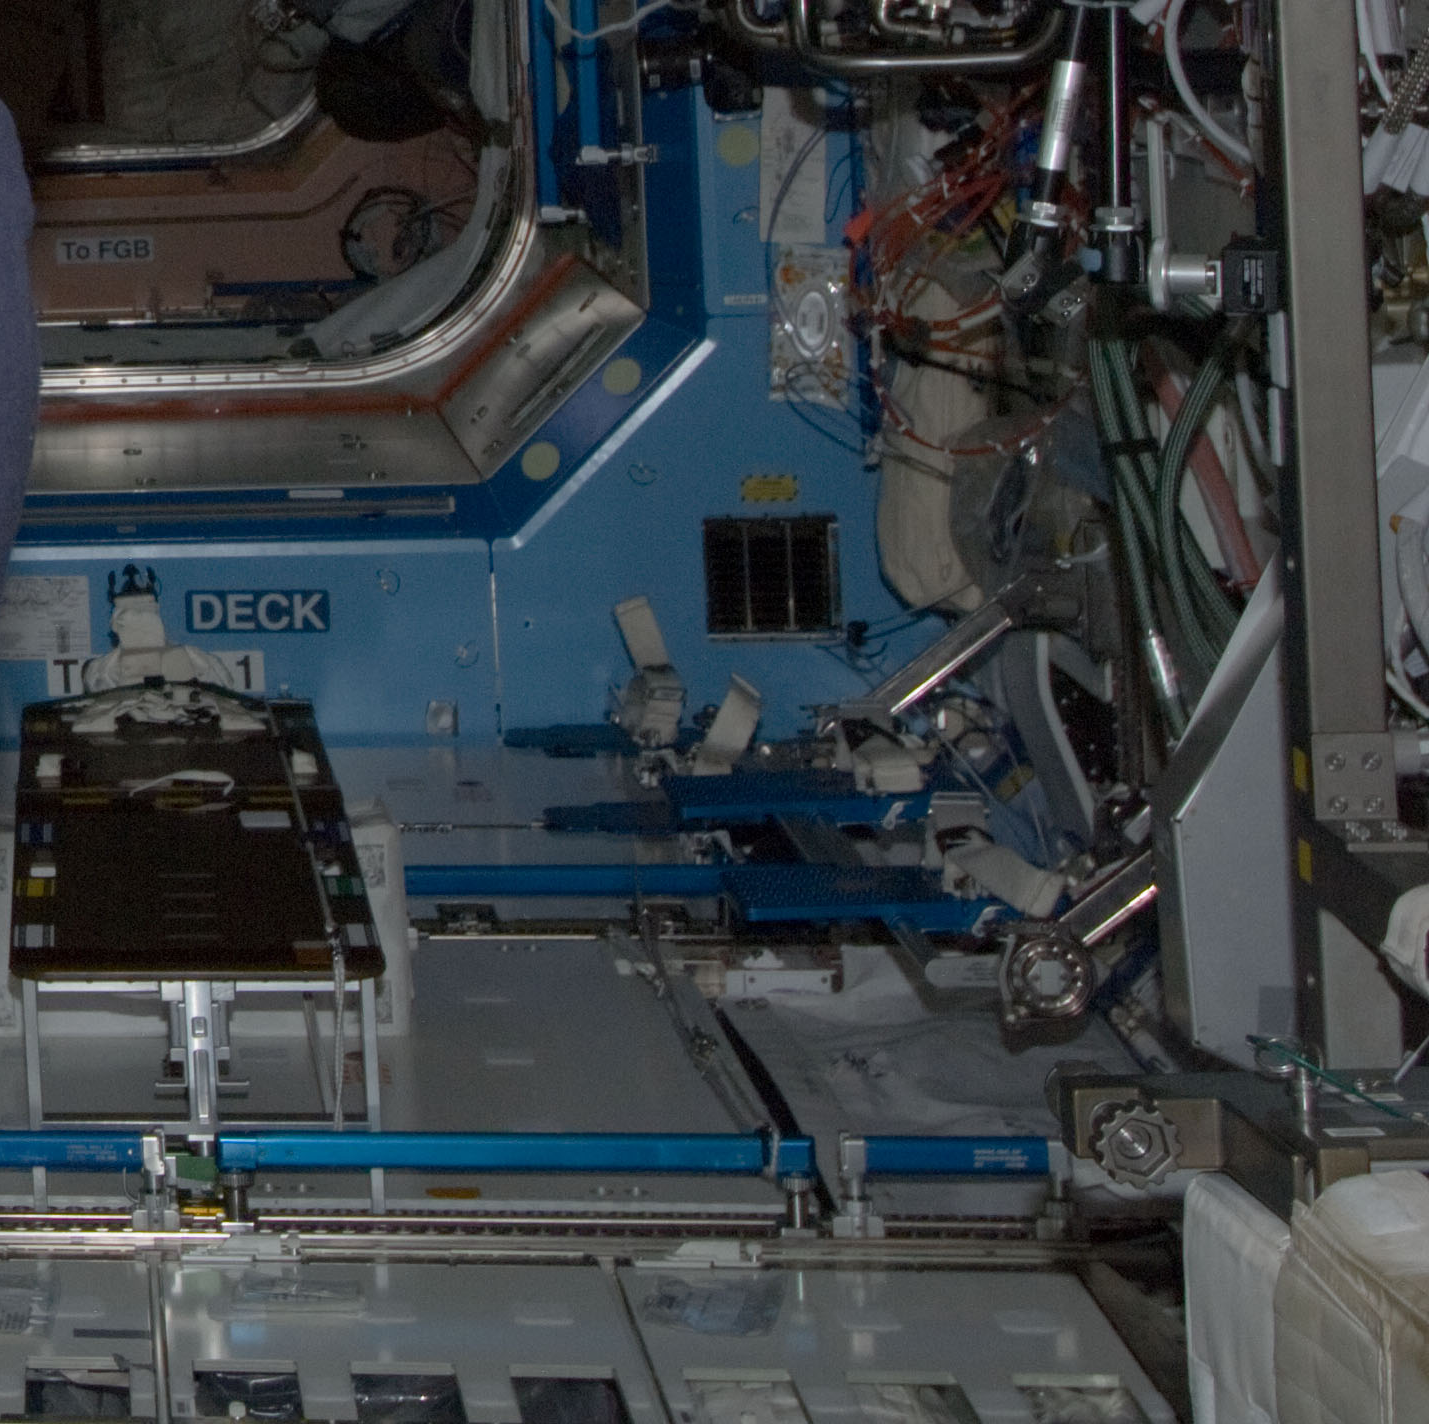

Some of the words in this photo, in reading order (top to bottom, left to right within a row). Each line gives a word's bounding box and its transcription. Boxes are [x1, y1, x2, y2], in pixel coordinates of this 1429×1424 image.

[62, 241, 91, 261] To
[97, 239, 151, 260] FGB
[190, 592, 328, 632] DECK
[238, 655, 251, 689] 1
